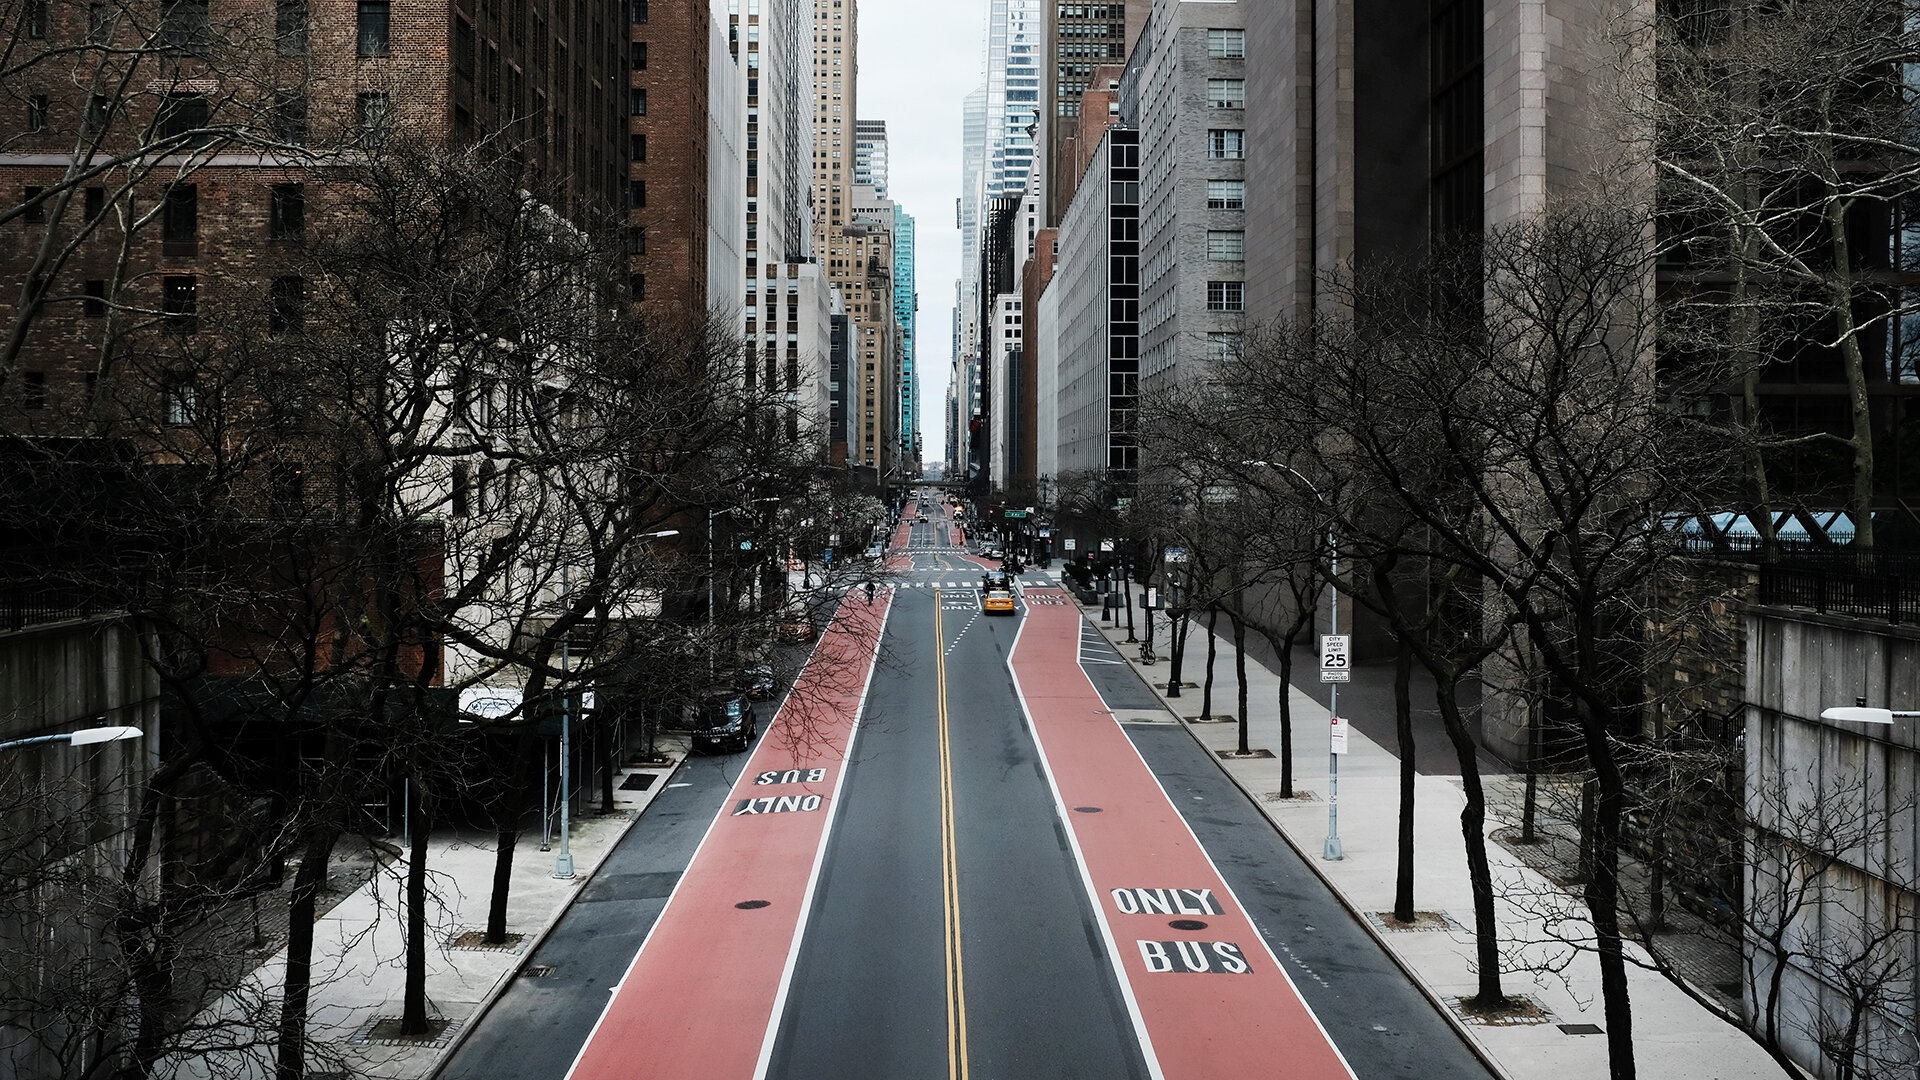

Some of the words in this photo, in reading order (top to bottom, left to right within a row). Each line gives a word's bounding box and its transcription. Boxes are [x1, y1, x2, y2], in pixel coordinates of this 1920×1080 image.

[1325, 654, 1346, 667] 25
[757, 767, 827, 786] BUS
[732, 795, 822, 816] ONLY
[1111, 888, 1216, 915] ONLY
[1136, 939, 1248, 974] BUS
